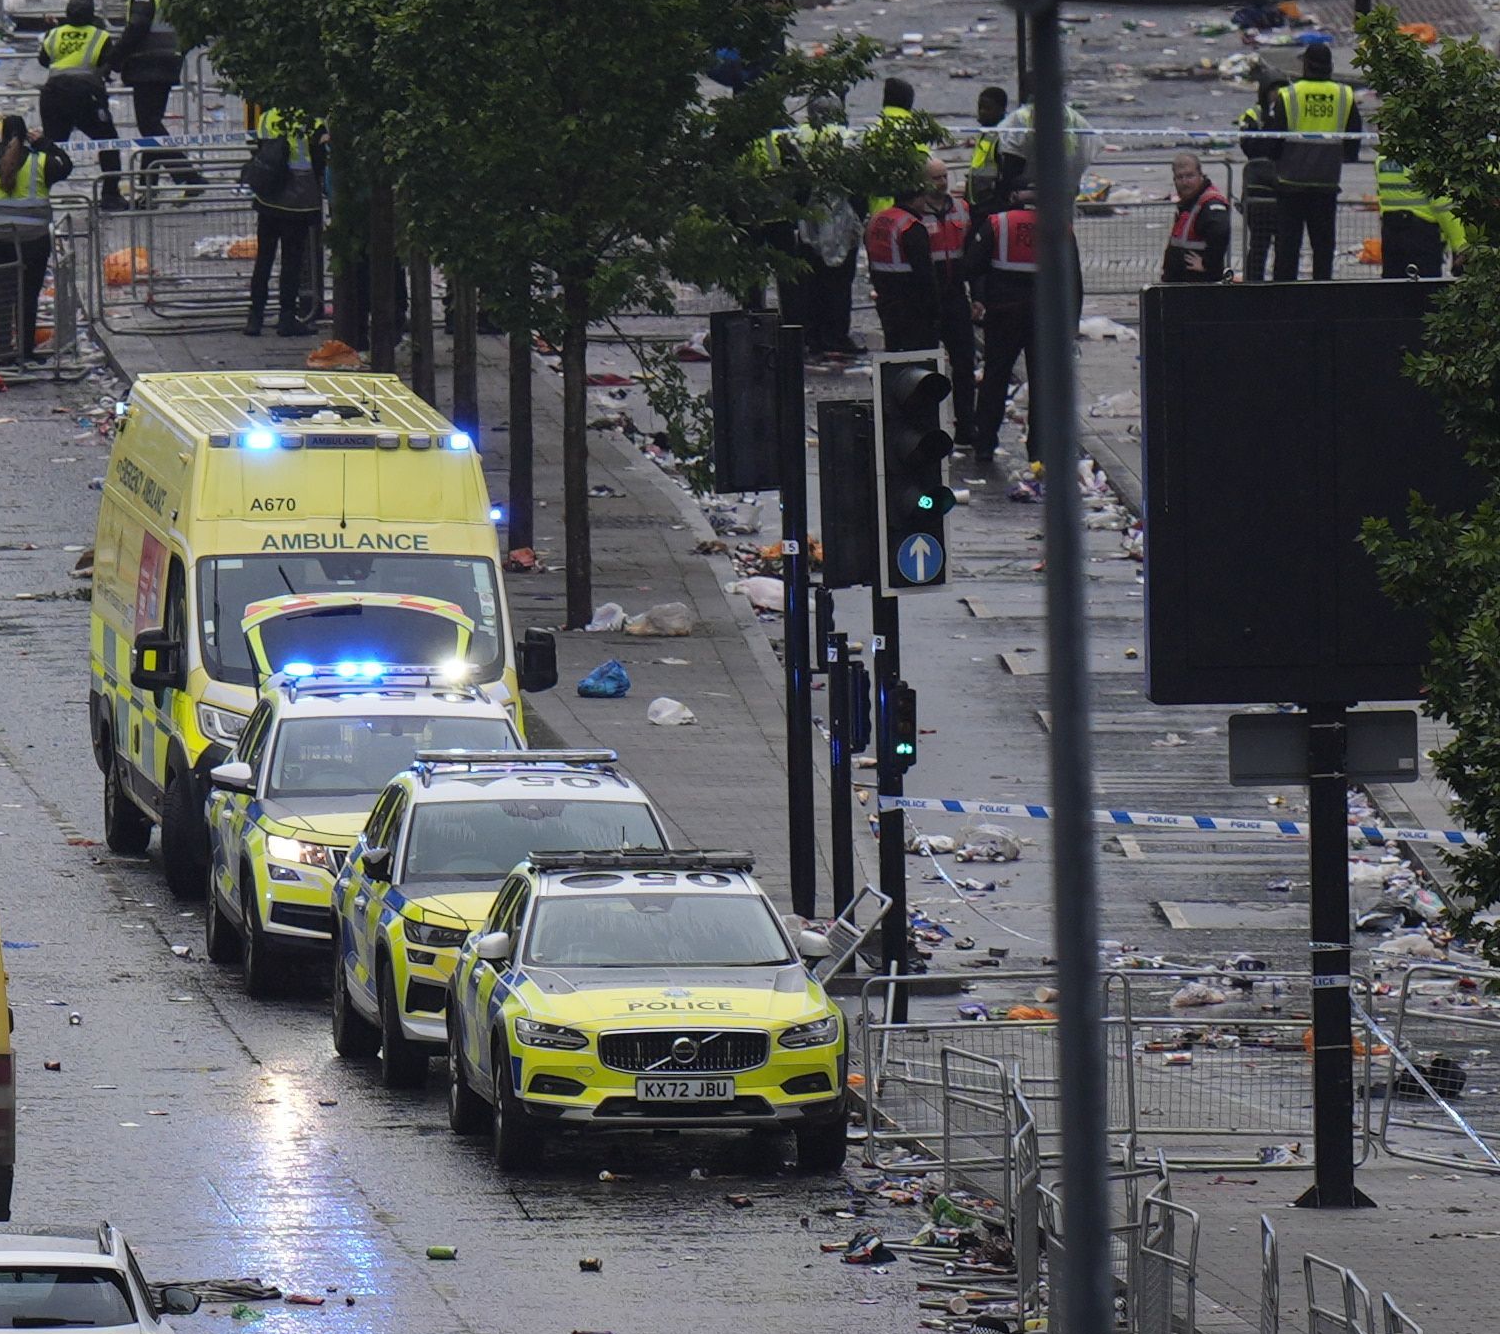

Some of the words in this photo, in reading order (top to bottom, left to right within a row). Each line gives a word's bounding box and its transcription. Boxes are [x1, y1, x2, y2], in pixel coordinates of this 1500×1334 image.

[1304, 105, 1333, 118] HE99
[312, 437, 369, 446] AMBULANCE
[250, 497, 297, 513] A670
[261, 533, 430, 552] AMBULANCE
[895, 799, 927, 809] POLICE
[979, 804, 1011, 814] POLICE
[1147, 815, 1180, 825] POLICE
[1230, 820, 1262, 830] POLICE
[1397, 830, 1430, 840] POLICE
[628, 1001, 733, 1011] POLICE
[644, 1082, 690, 1098] KX72
[694, 1082, 728, 1098] JBU
